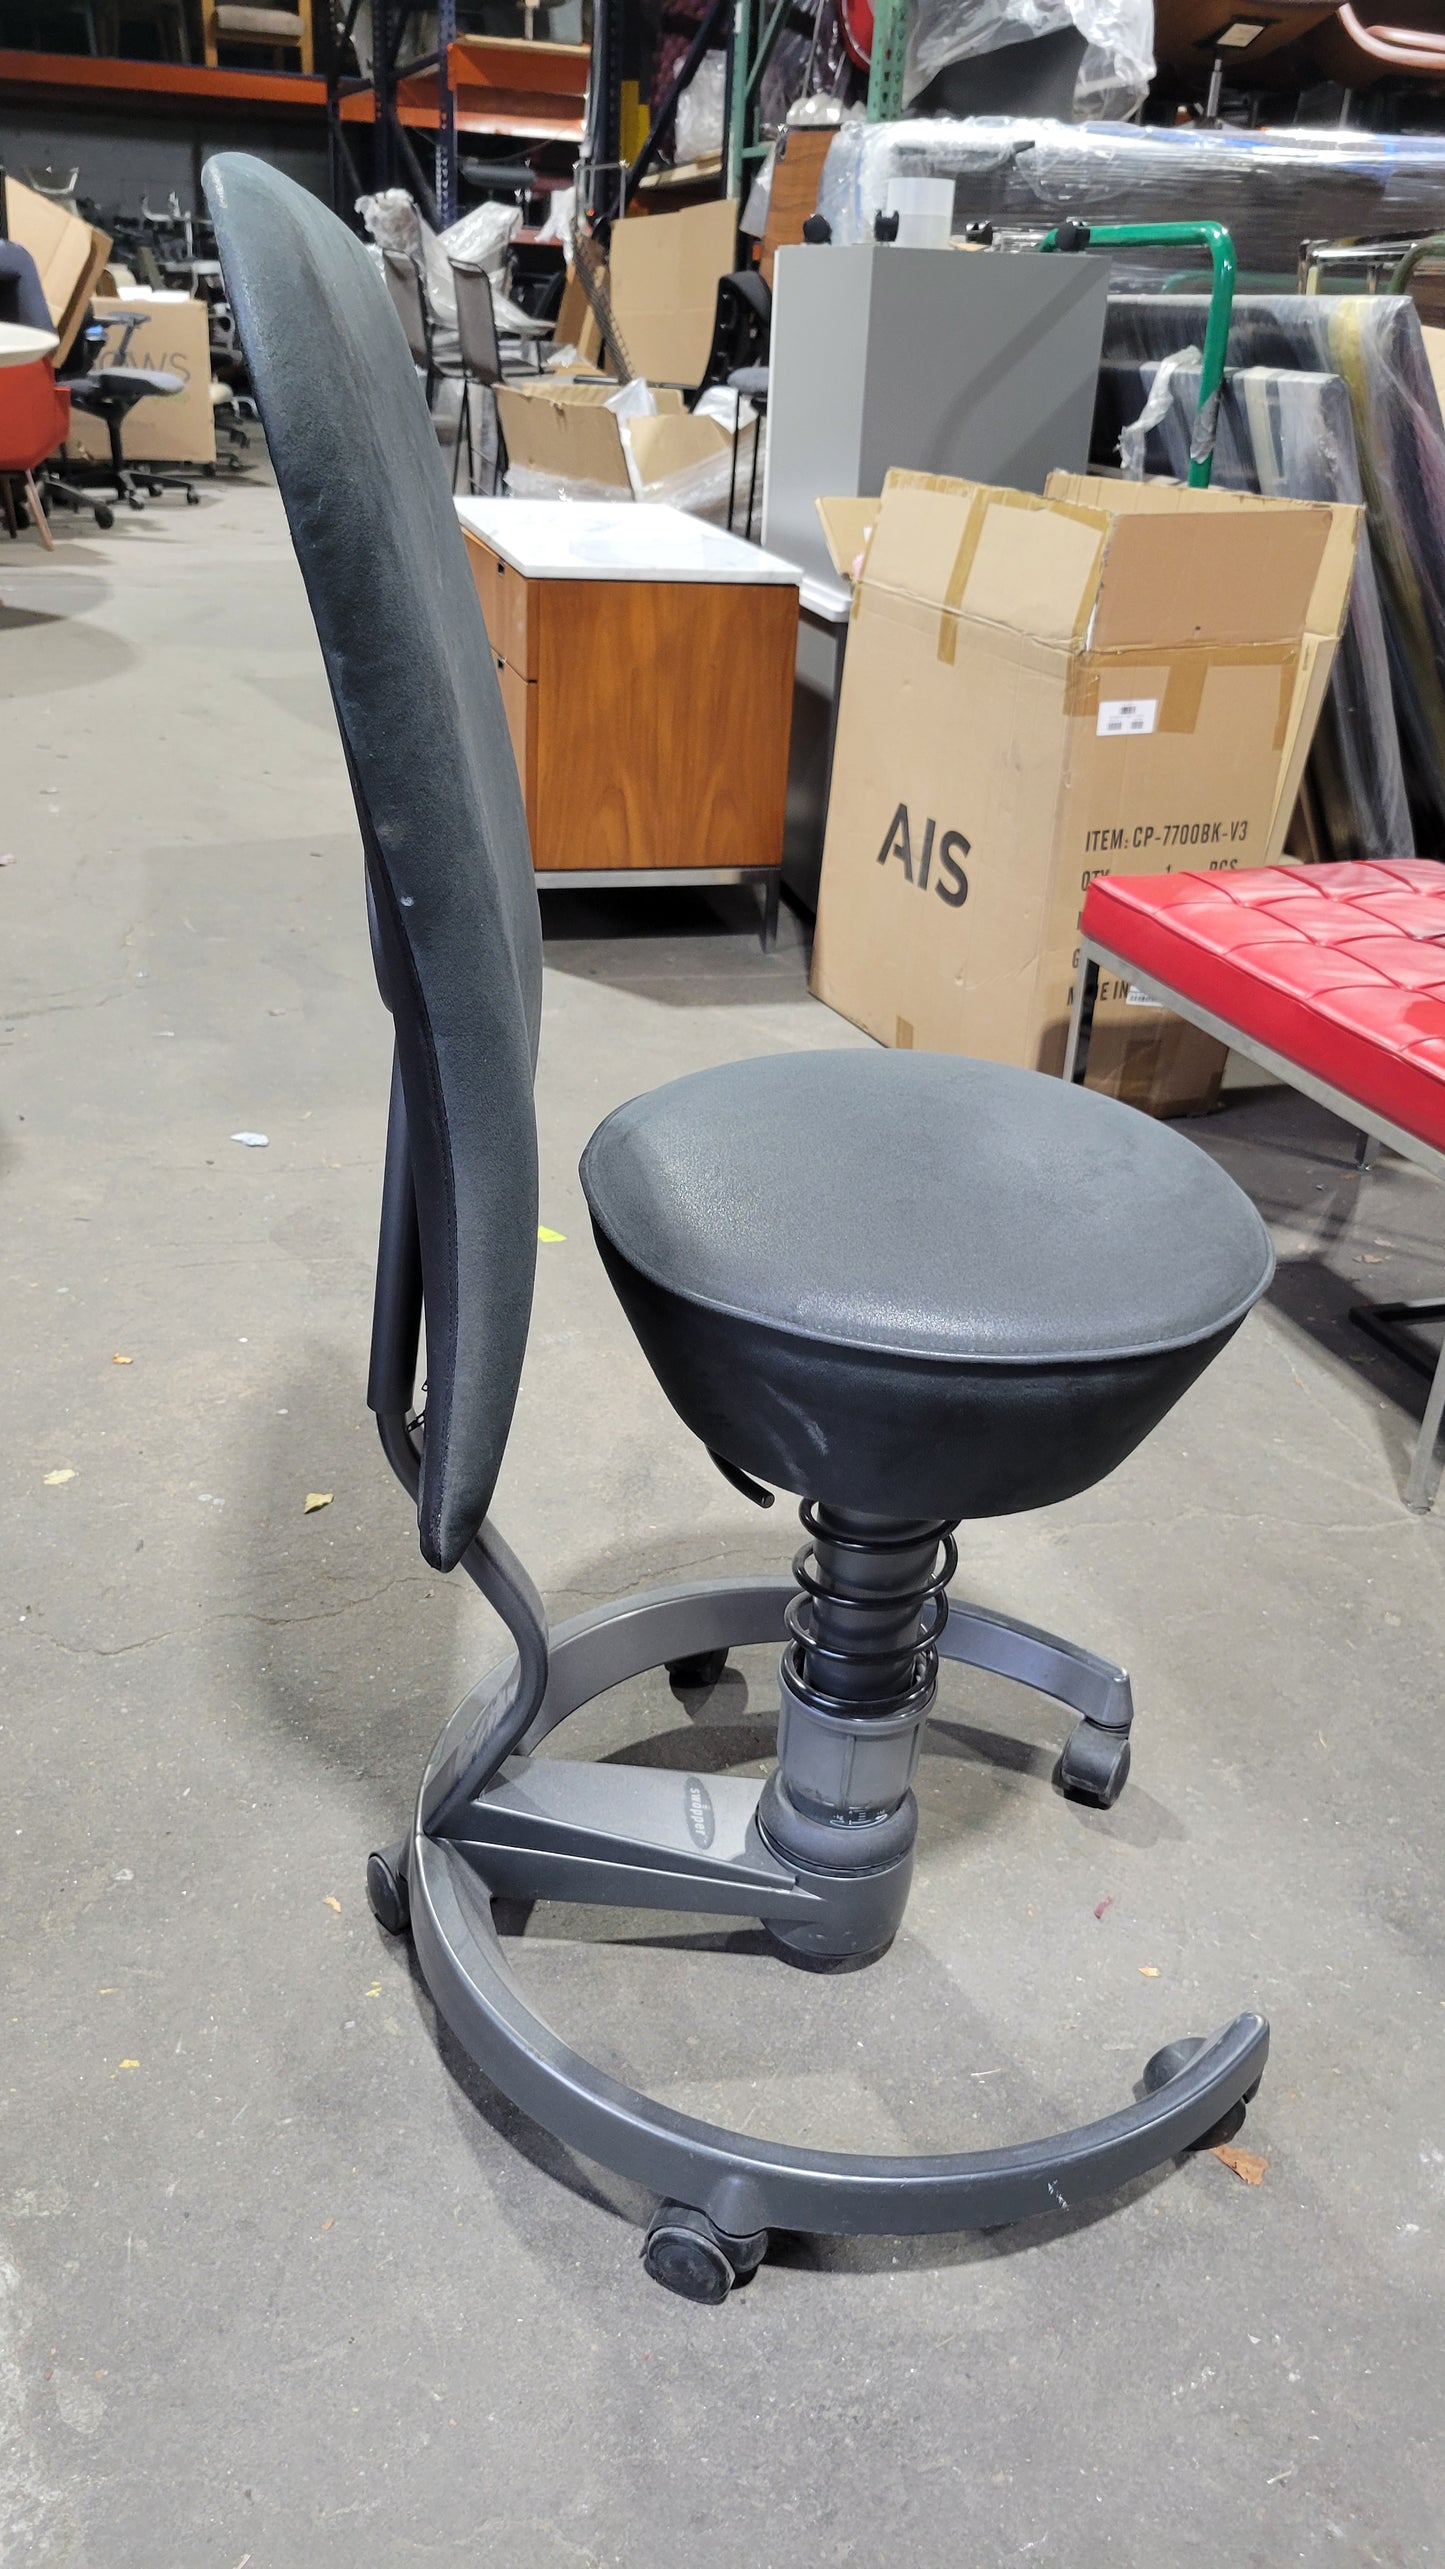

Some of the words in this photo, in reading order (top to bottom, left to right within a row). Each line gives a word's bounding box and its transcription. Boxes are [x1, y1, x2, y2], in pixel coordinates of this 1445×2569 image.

[876, 802, 971, 908] AIS
[1085, 828, 1129, 852] ITEM:
[1132, 820, 1248, 848] CP-7700BK-V3
[690, 1787, 706, 1836] swopper
